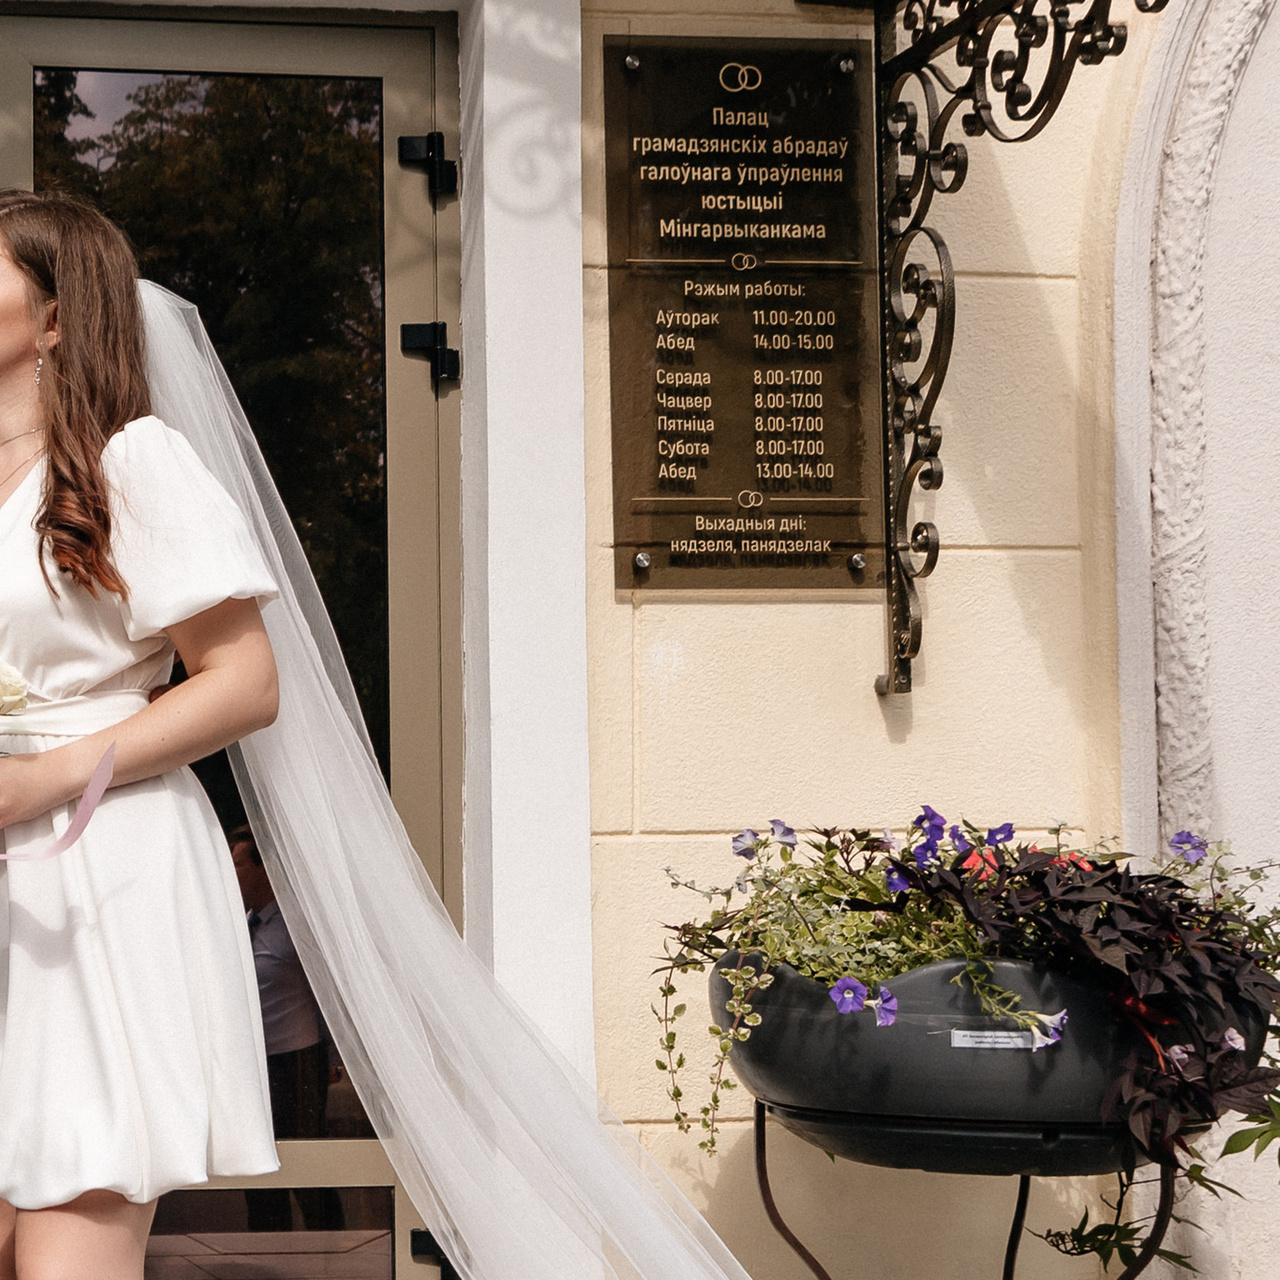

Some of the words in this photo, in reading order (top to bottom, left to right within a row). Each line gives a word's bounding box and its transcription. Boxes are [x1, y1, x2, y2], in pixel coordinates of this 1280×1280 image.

[713, 107, 769, 128] Палац
[632, 135, 767, 155] грамадзянскіх
[772, 136, 848, 158] абрадаў
[640, 164, 731, 184] галоўнага
[737, 164, 843, 185] ўпраўлення
[701, 192, 783, 212] юстыцыі
[659, 219, 826, 241] Мінгарвыканкама
[684, 280, 739, 296] Рэжым
[744, 280, 806, 299] работы:
[656, 310, 719, 328] Аўторак
[753, 310, 836, 326] 11.00-20.00
[656, 333, 695, 351] Абед
[753, 334, 834, 350] 14.00-15.00
[656, 369, 711, 387] Серада
[753, 370, 822, 385] 8.00-17.00
[657, 393, 712, 411] Чацвер
[754, 393, 823, 408] 8.00-17.00
[657, 415, 714, 433] Пятніца
[755, 416, 823, 431] 8.00-17.00
[658, 440, 709, 458] Субота
[756, 440, 824, 455] 8.00-17.00
[658, 463, 697, 480] Абед
[756, 463, 834, 479] 13.00-14.00
[695, 515, 775, 533] Выхадныя
[779, 515, 806, 533] дні:
[670, 539, 737, 554] нядзеля,
[741, 539, 831, 554] панядзелак
